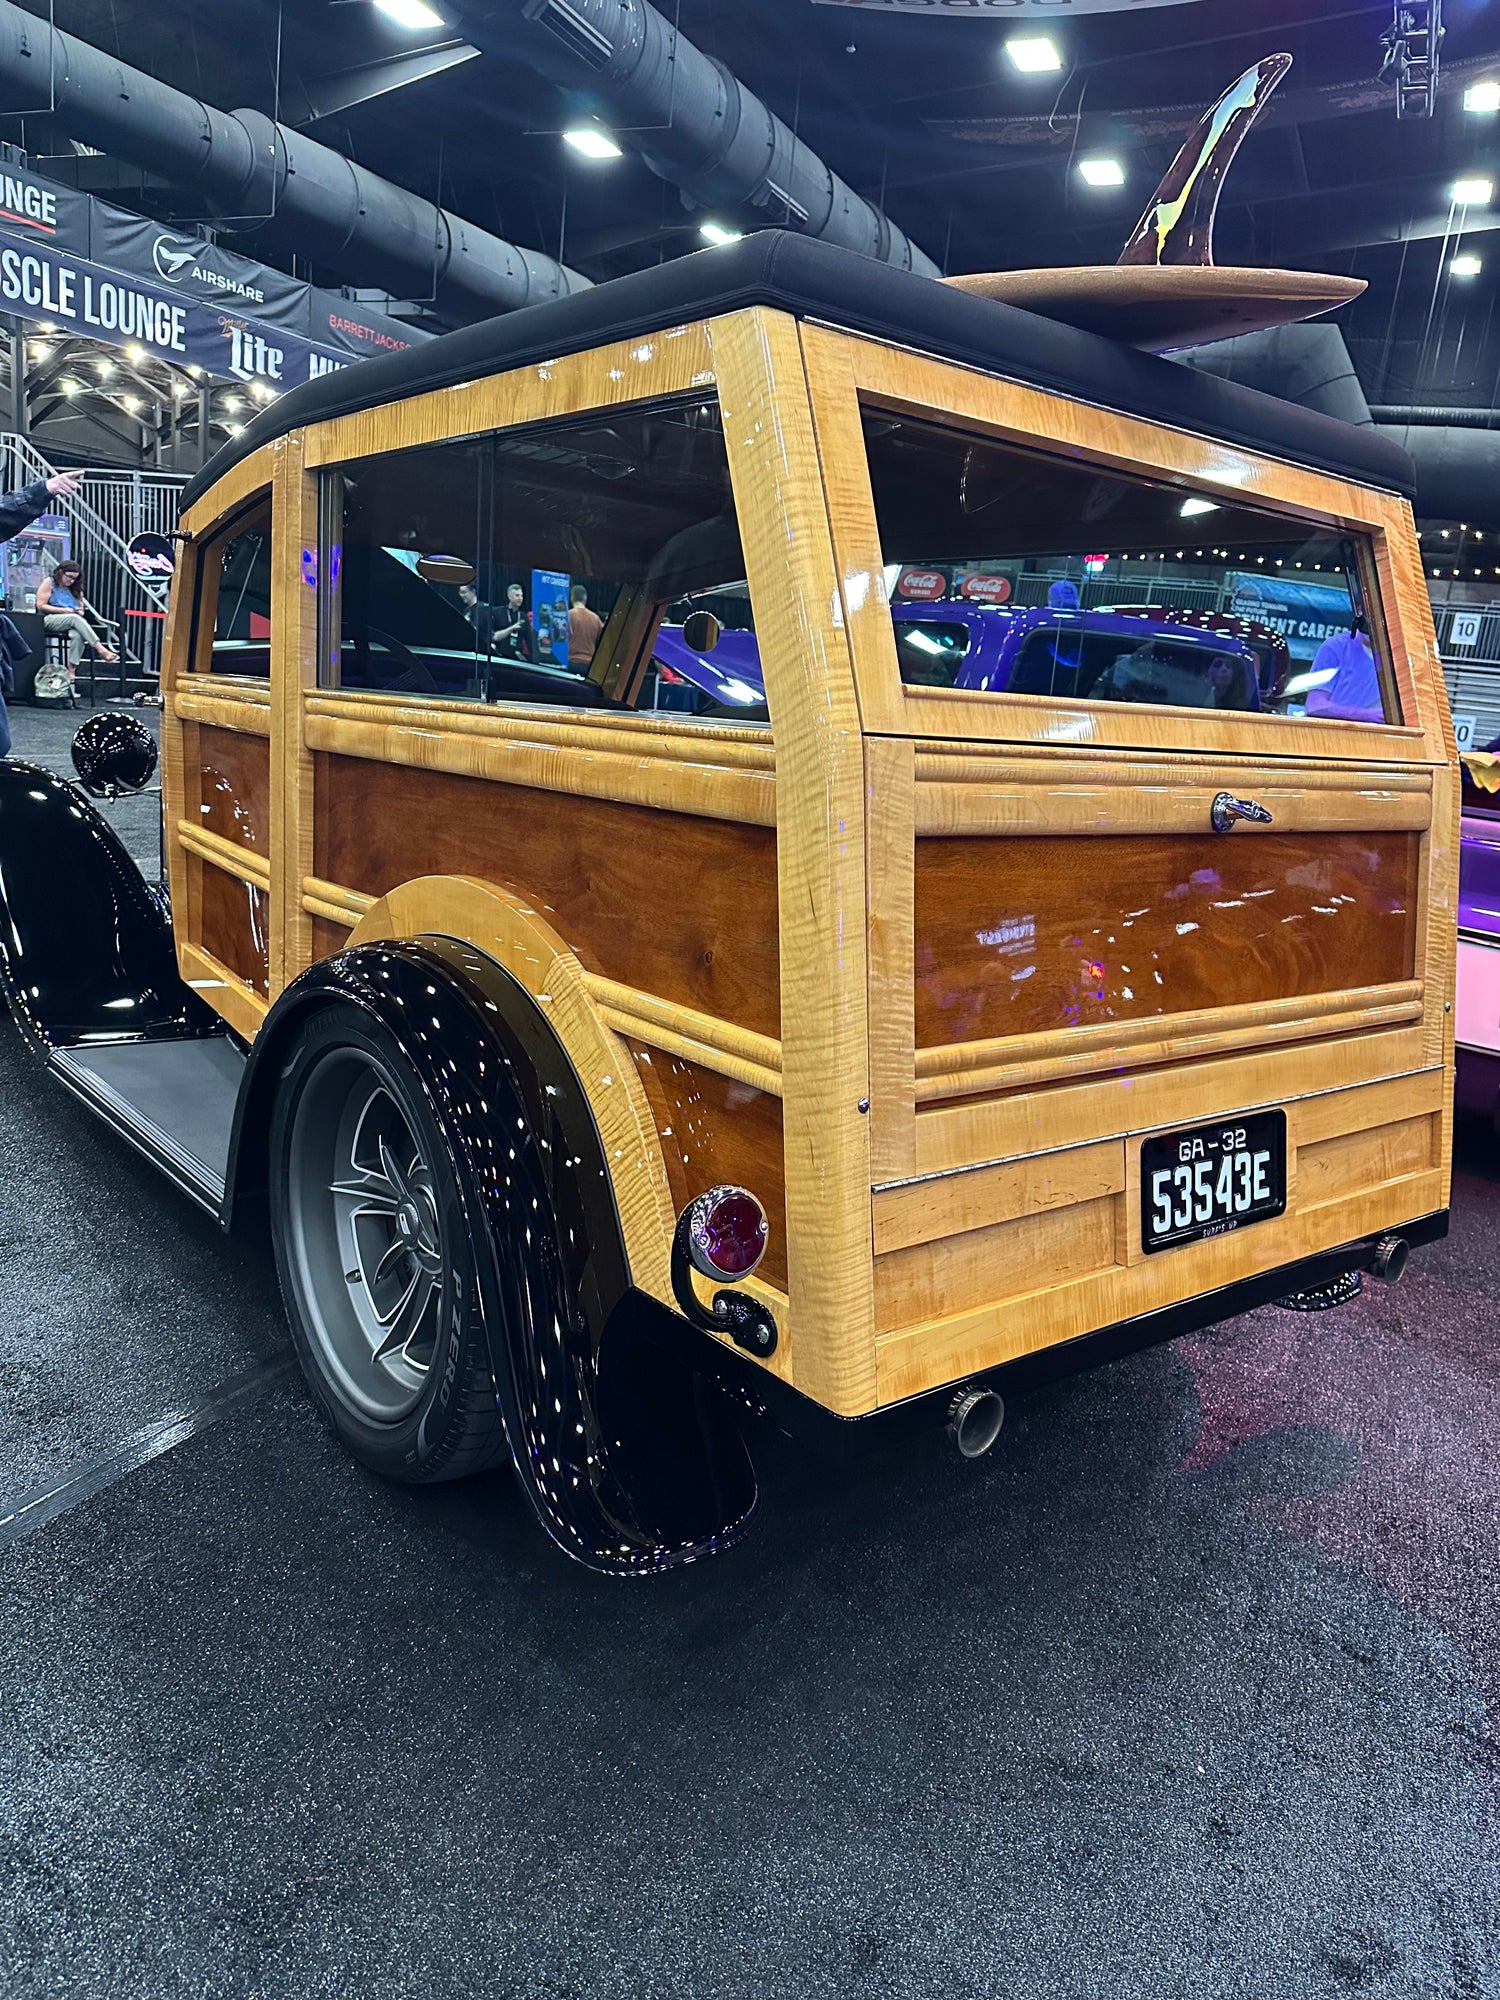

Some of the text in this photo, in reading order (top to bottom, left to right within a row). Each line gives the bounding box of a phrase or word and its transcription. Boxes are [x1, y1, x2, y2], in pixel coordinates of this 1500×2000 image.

[0, 249, 187, 352] SCLE LOUNGE
[191, 266, 264, 303] AIRSHARE
[228, 326, 284, 381] Lite
[329, 314, 375, 342] BARRETT
[1456, 622, 1475, 637] 10
[1151, 1150, 1271, 1234] 53543E
[439, 1268, 462, 1409] P ZERO
